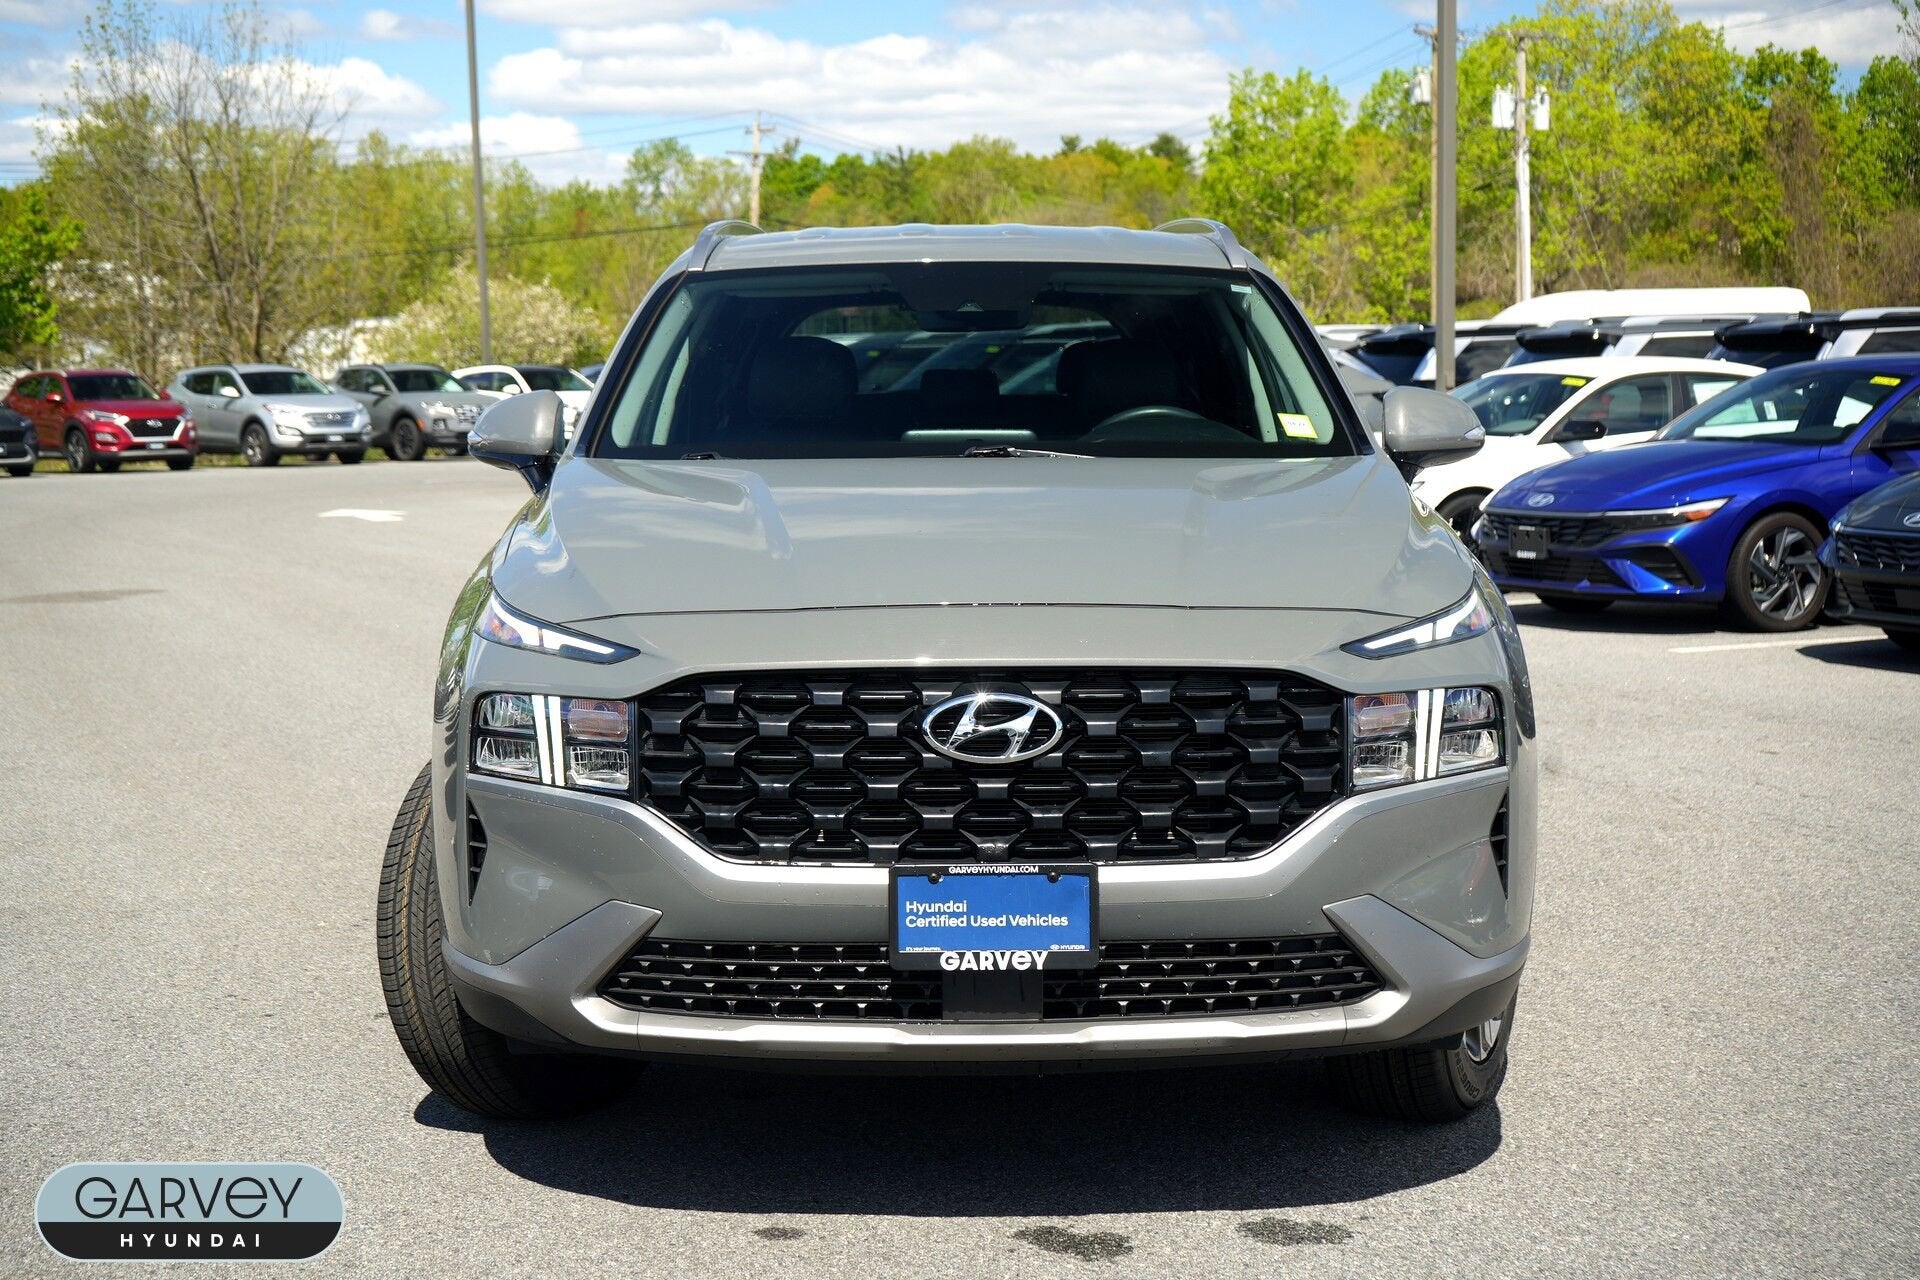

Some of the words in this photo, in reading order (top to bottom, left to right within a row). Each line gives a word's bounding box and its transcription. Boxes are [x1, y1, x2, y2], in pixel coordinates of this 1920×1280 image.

[905, 900, 968, 915] Hyundai
[905, 915, 968, 928] Certified
[970, 914, 1007, 927] Used
[1009, 914, 1069, 927] Vehicles
